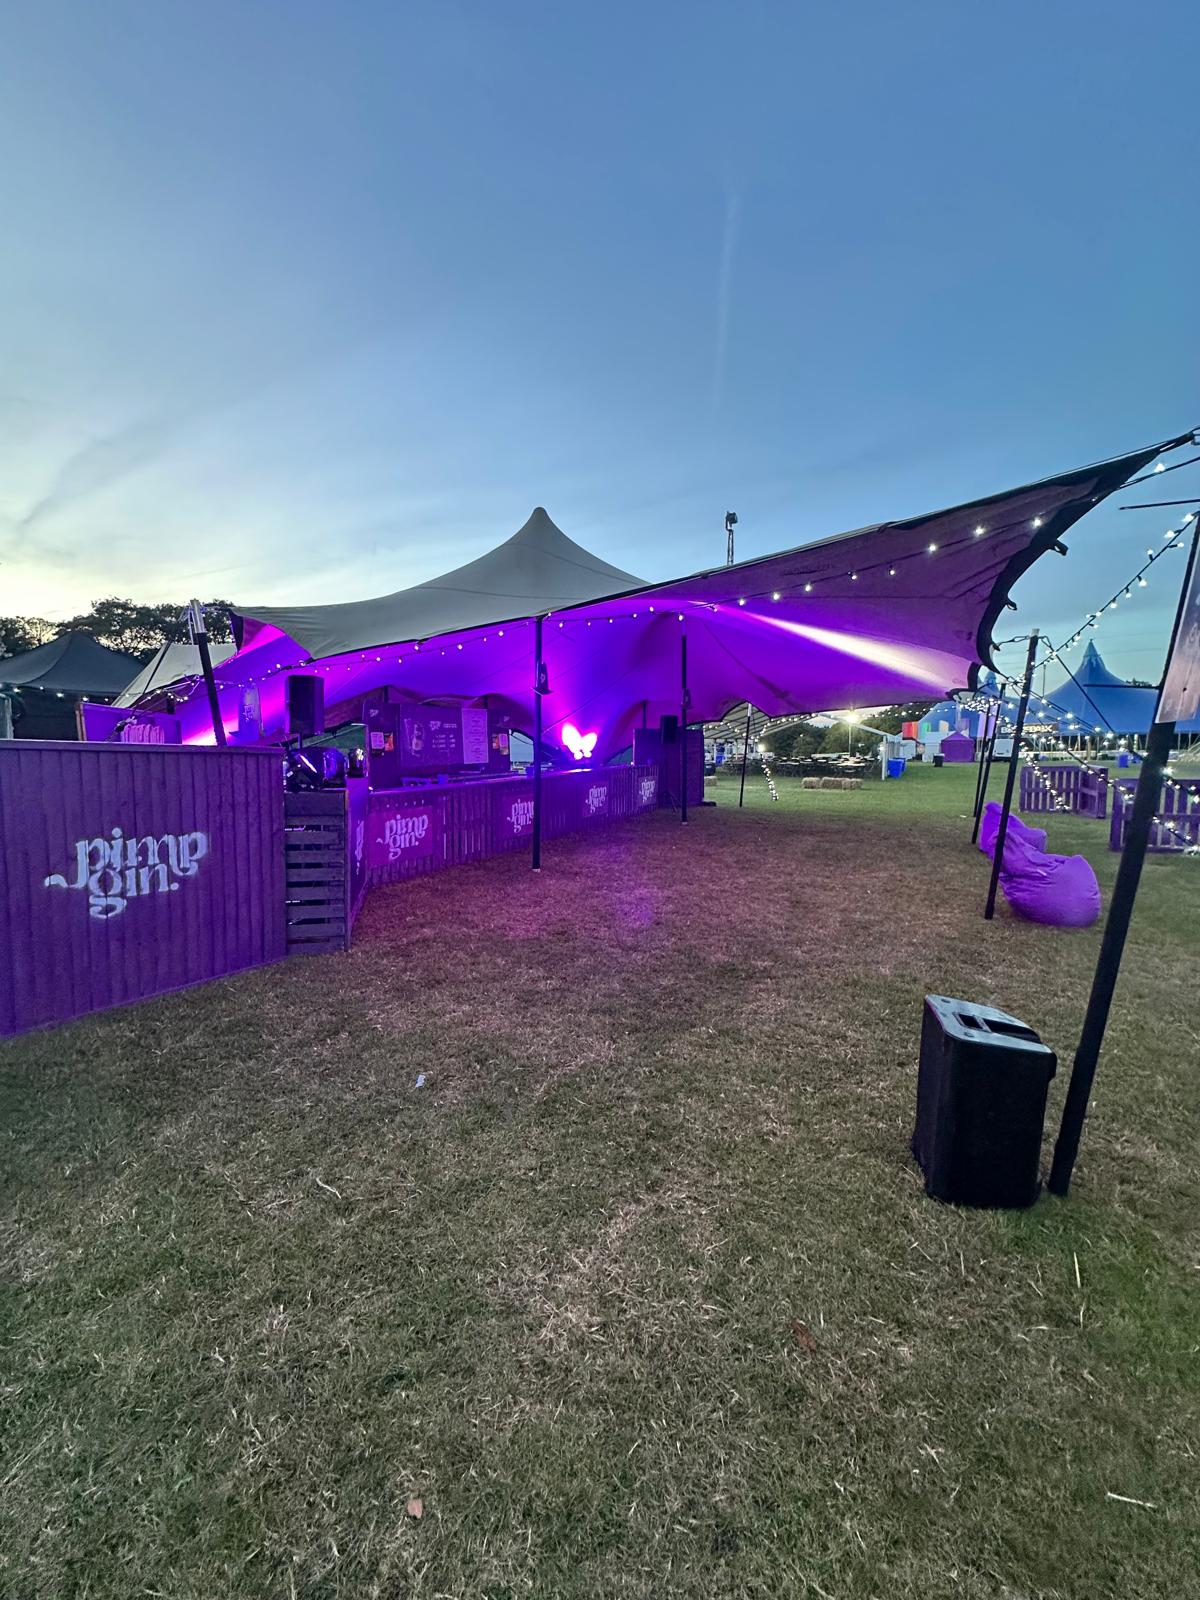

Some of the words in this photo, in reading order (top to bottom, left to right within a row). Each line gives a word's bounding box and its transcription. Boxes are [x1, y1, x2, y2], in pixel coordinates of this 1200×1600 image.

[507, 799, 534, 822] pim
[376, 815, 429, 845] pimp
[44, 827, 208, 889] pimp
[389, 832, 419, 860] gin.
[88, 863, 179, 919] gin.
